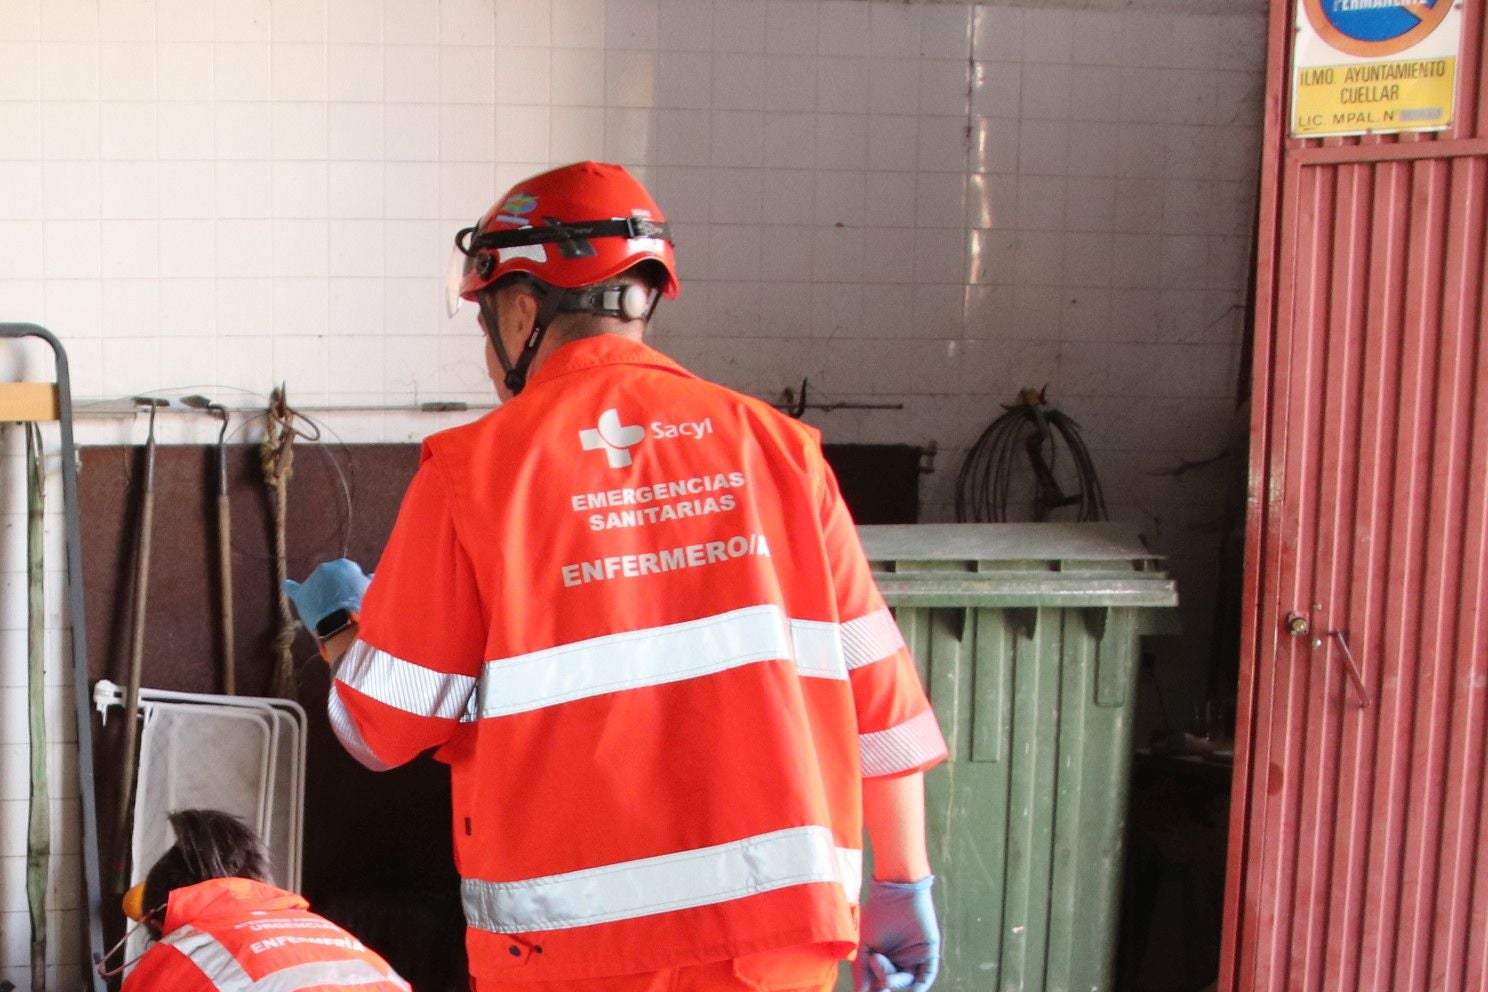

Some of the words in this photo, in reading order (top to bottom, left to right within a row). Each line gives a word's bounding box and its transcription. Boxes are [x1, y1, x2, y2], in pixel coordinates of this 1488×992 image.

[1344, 60, 1446, 83] AYUNTAMIENTO
[1340, 84, 1399, 104] CUELLAR
[650, 418, 713, 440] Sacyl
[571, 471, 745, 512] EMERGENCIAS
[588, 494, 736, 531] SANITARIAS
